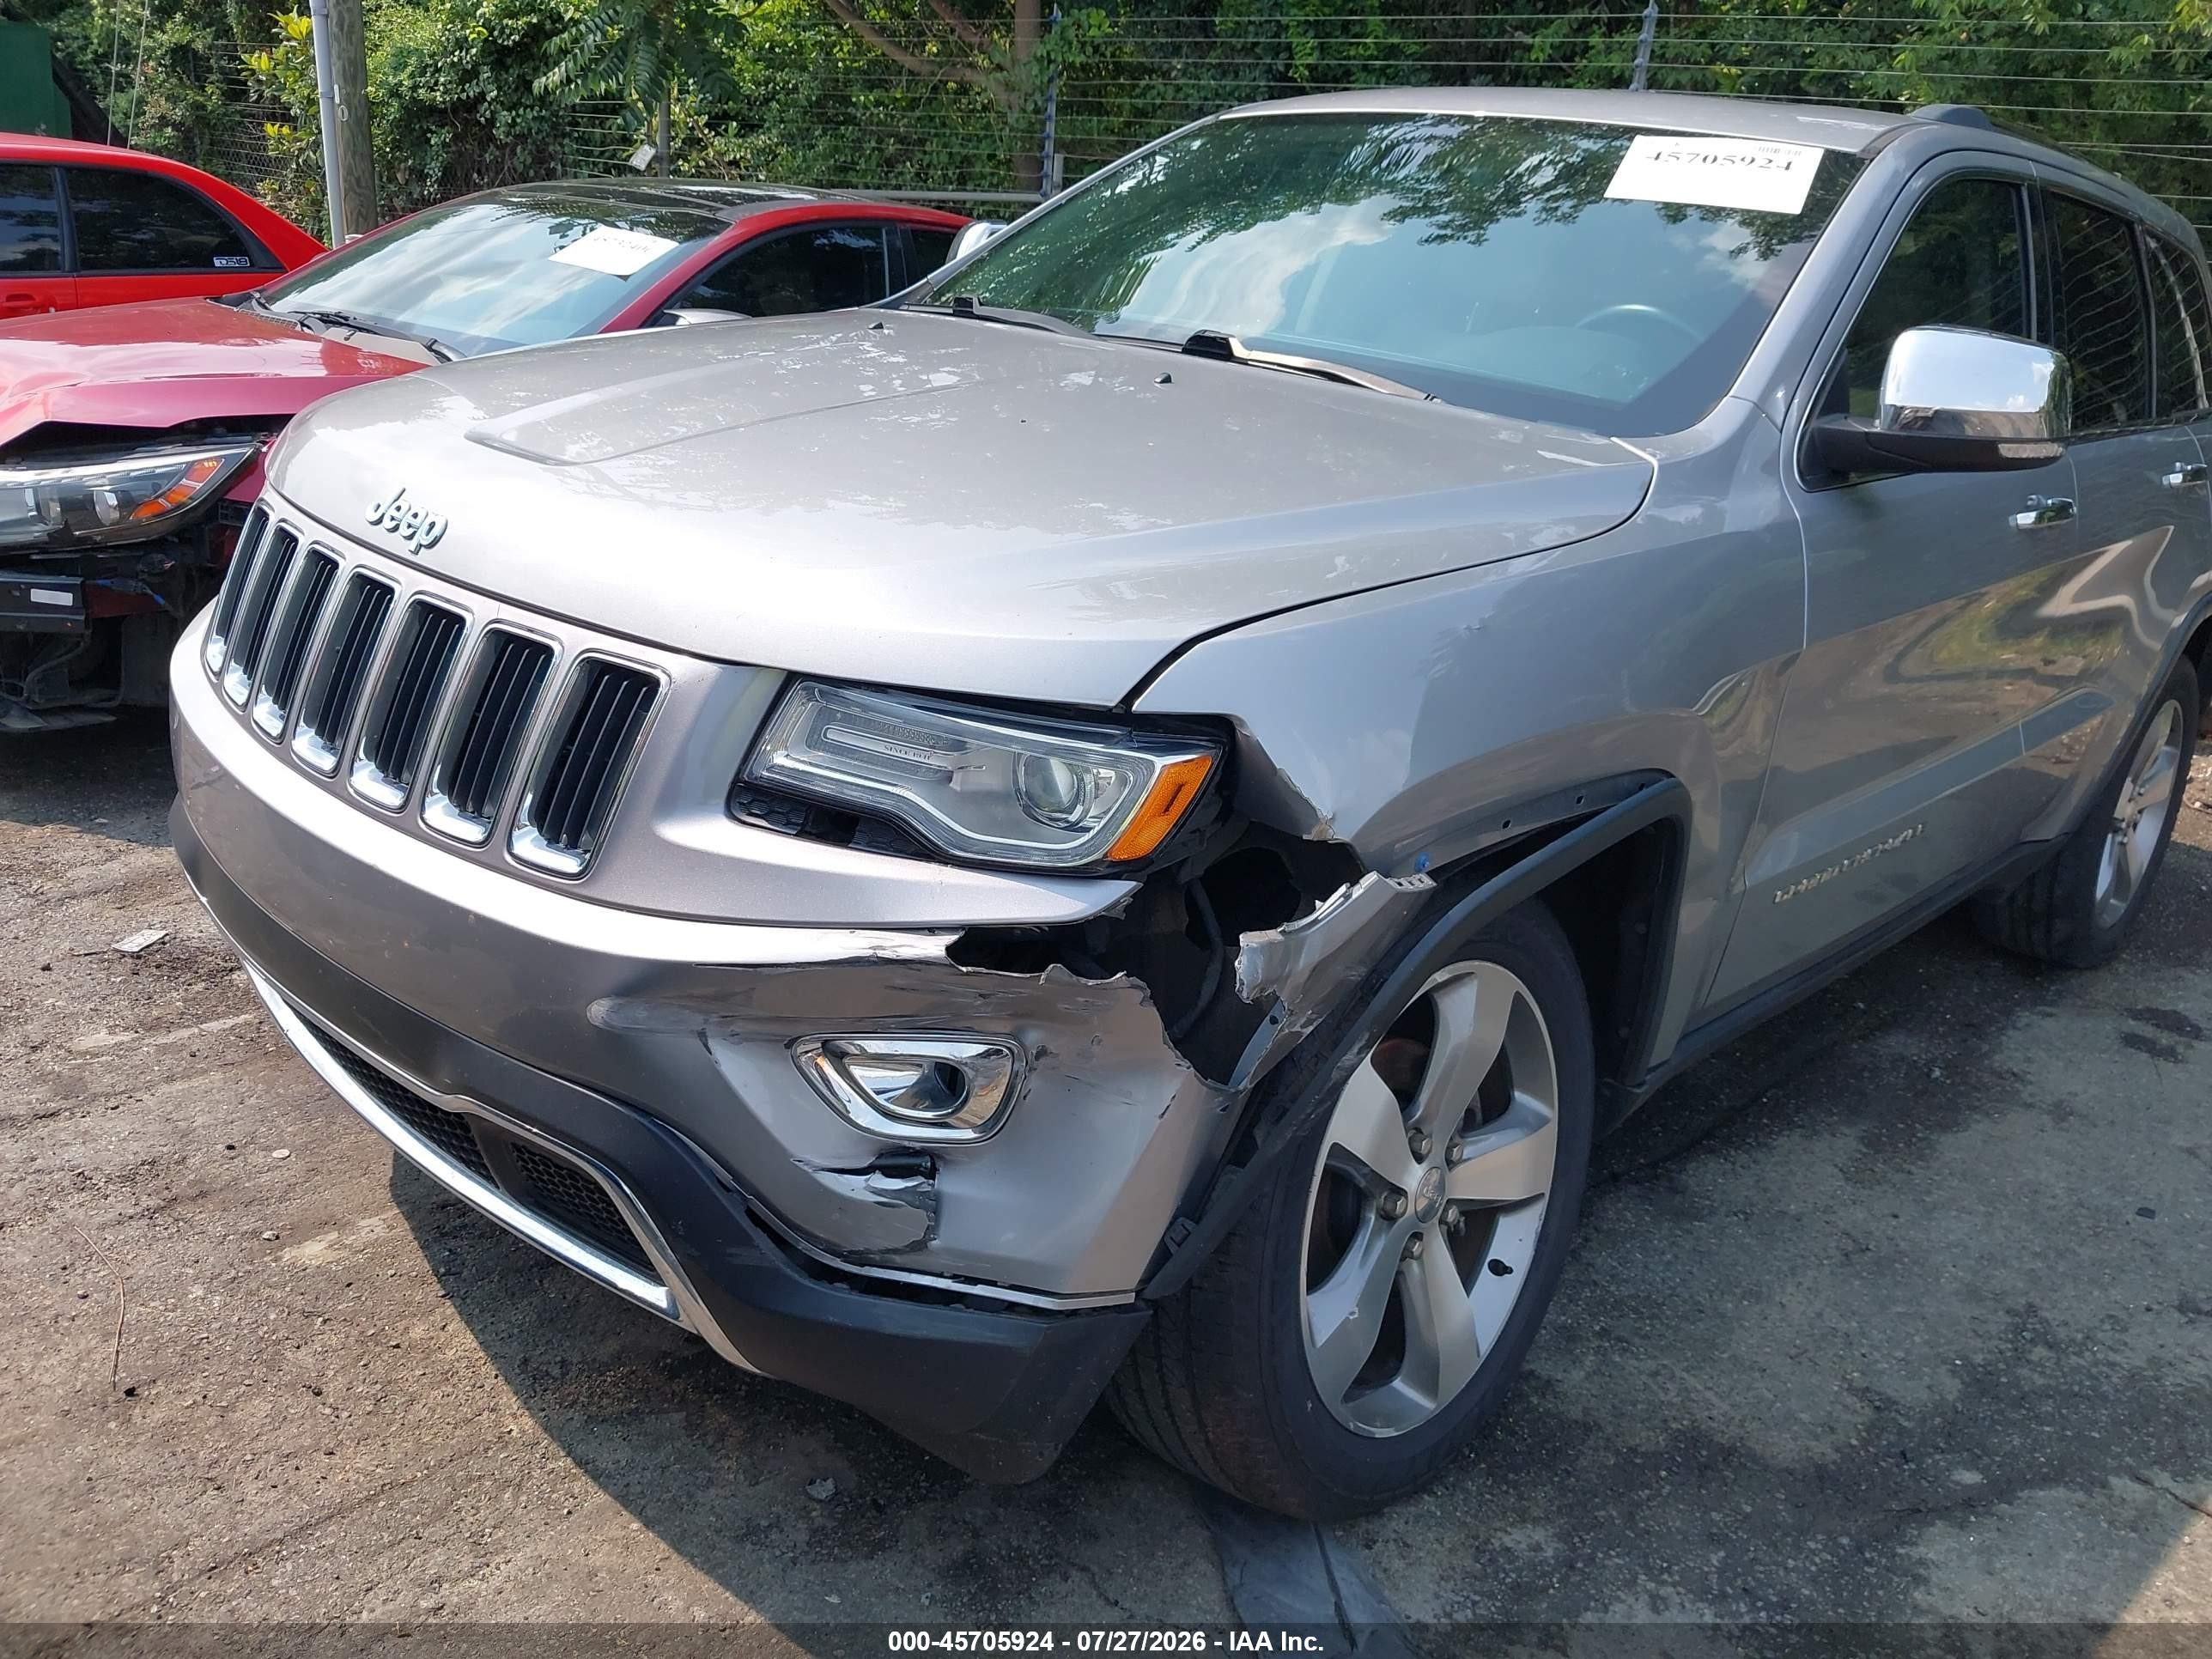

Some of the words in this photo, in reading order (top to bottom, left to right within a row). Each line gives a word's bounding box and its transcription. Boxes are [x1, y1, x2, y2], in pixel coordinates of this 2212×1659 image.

[1645, 150, 1793, 173] 45705924
[365, 488, 448, 556] Jeep
[884, 744, 910, 757] SINCE
